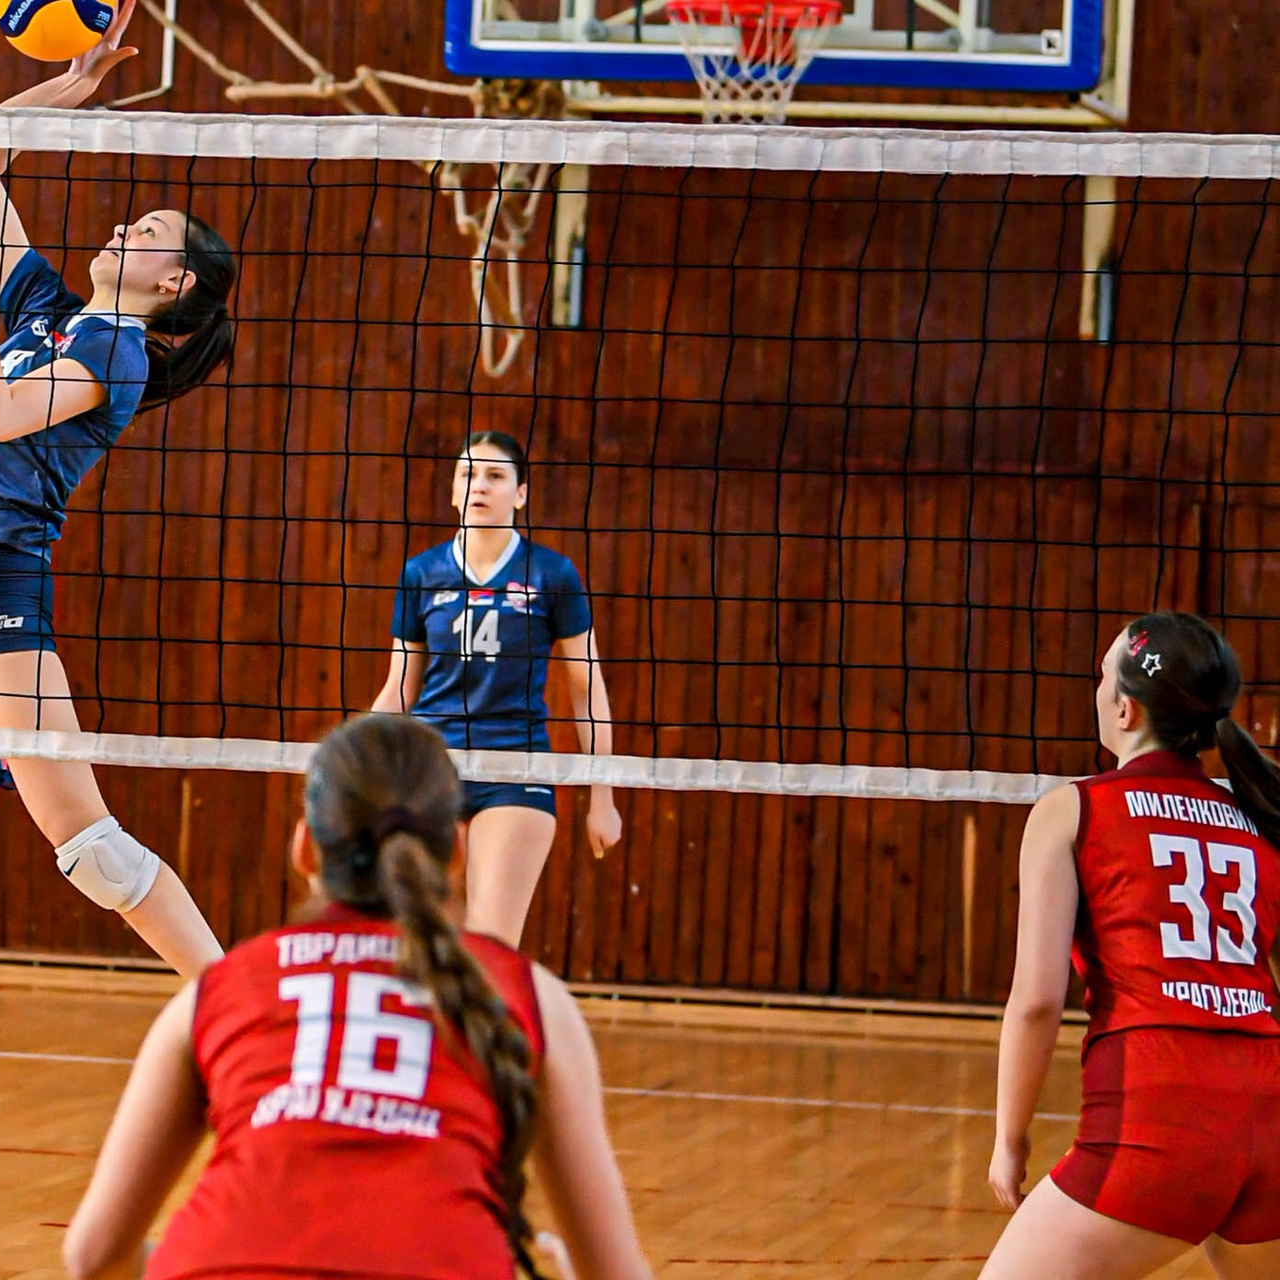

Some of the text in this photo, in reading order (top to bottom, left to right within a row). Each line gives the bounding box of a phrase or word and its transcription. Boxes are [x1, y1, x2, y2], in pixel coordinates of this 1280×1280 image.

[452, 609, 501, 662] 14
[1148, 833, 1257, 966] 33
[278, 971, 434, 1099] 16
